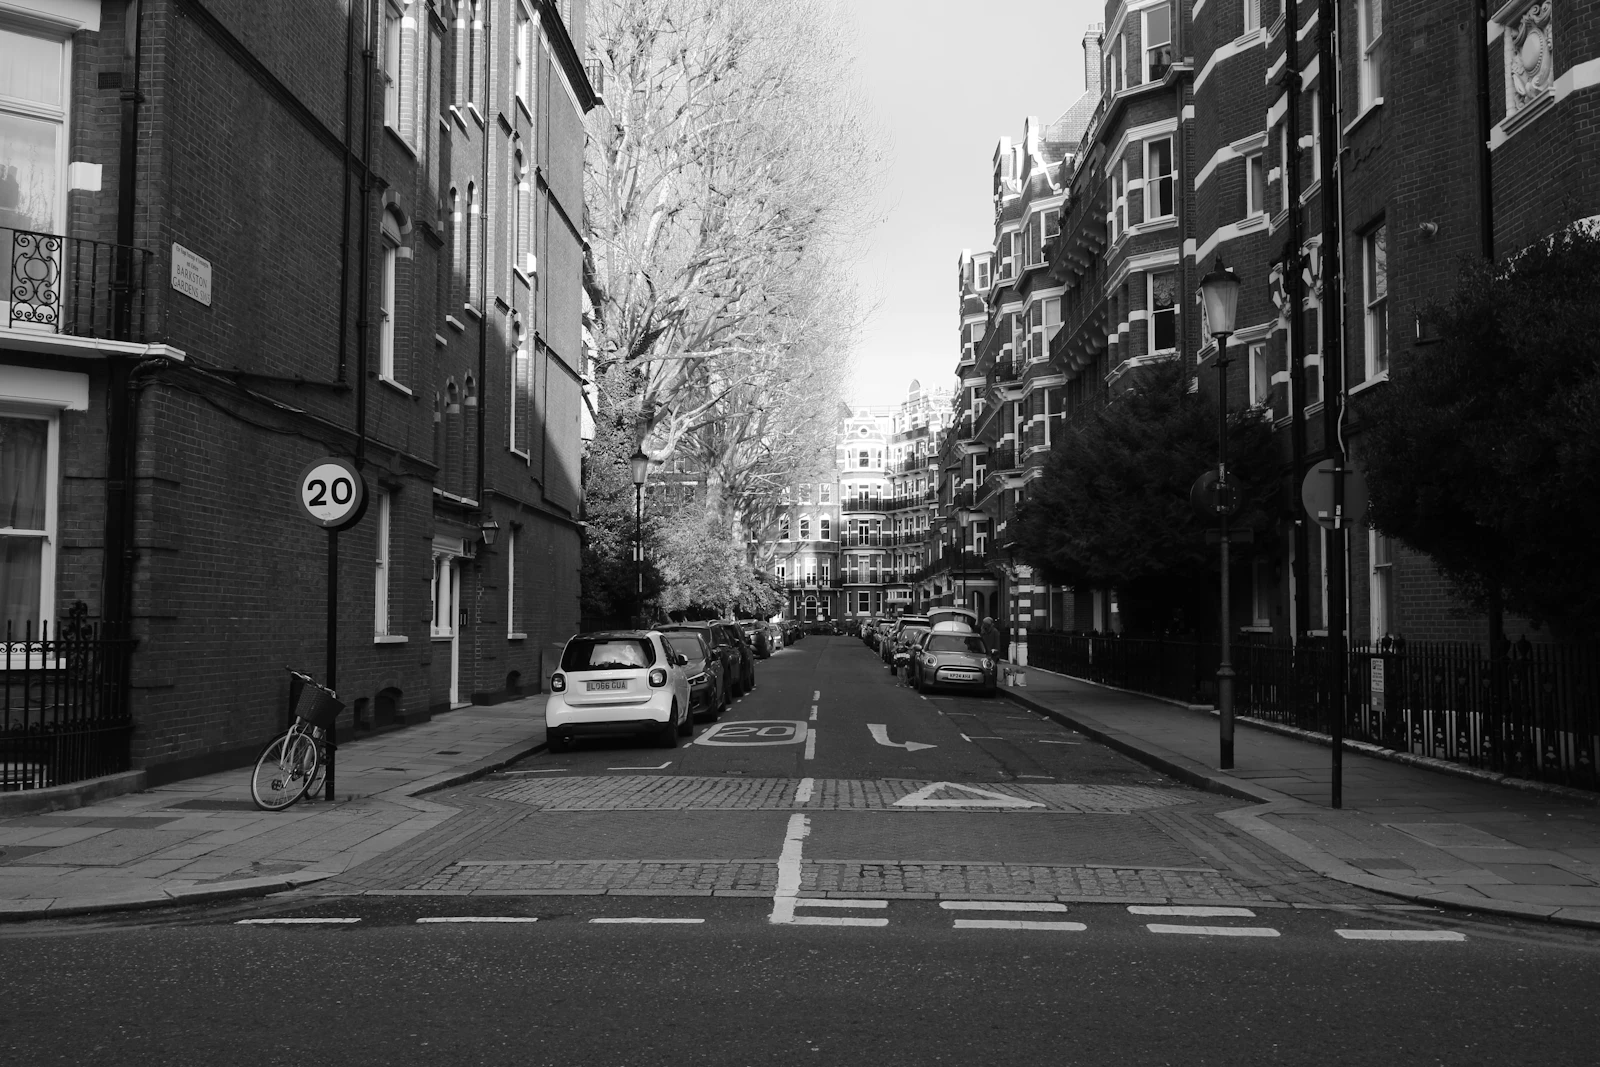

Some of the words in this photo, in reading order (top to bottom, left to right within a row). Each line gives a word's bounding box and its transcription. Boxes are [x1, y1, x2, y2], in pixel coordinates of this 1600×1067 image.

[177, 264, 207, 288] BARKSTON
[307, 477, 353, 507] 20
[611, 681, 626, 689] GUA
[713, 726, 796, 737] 20
